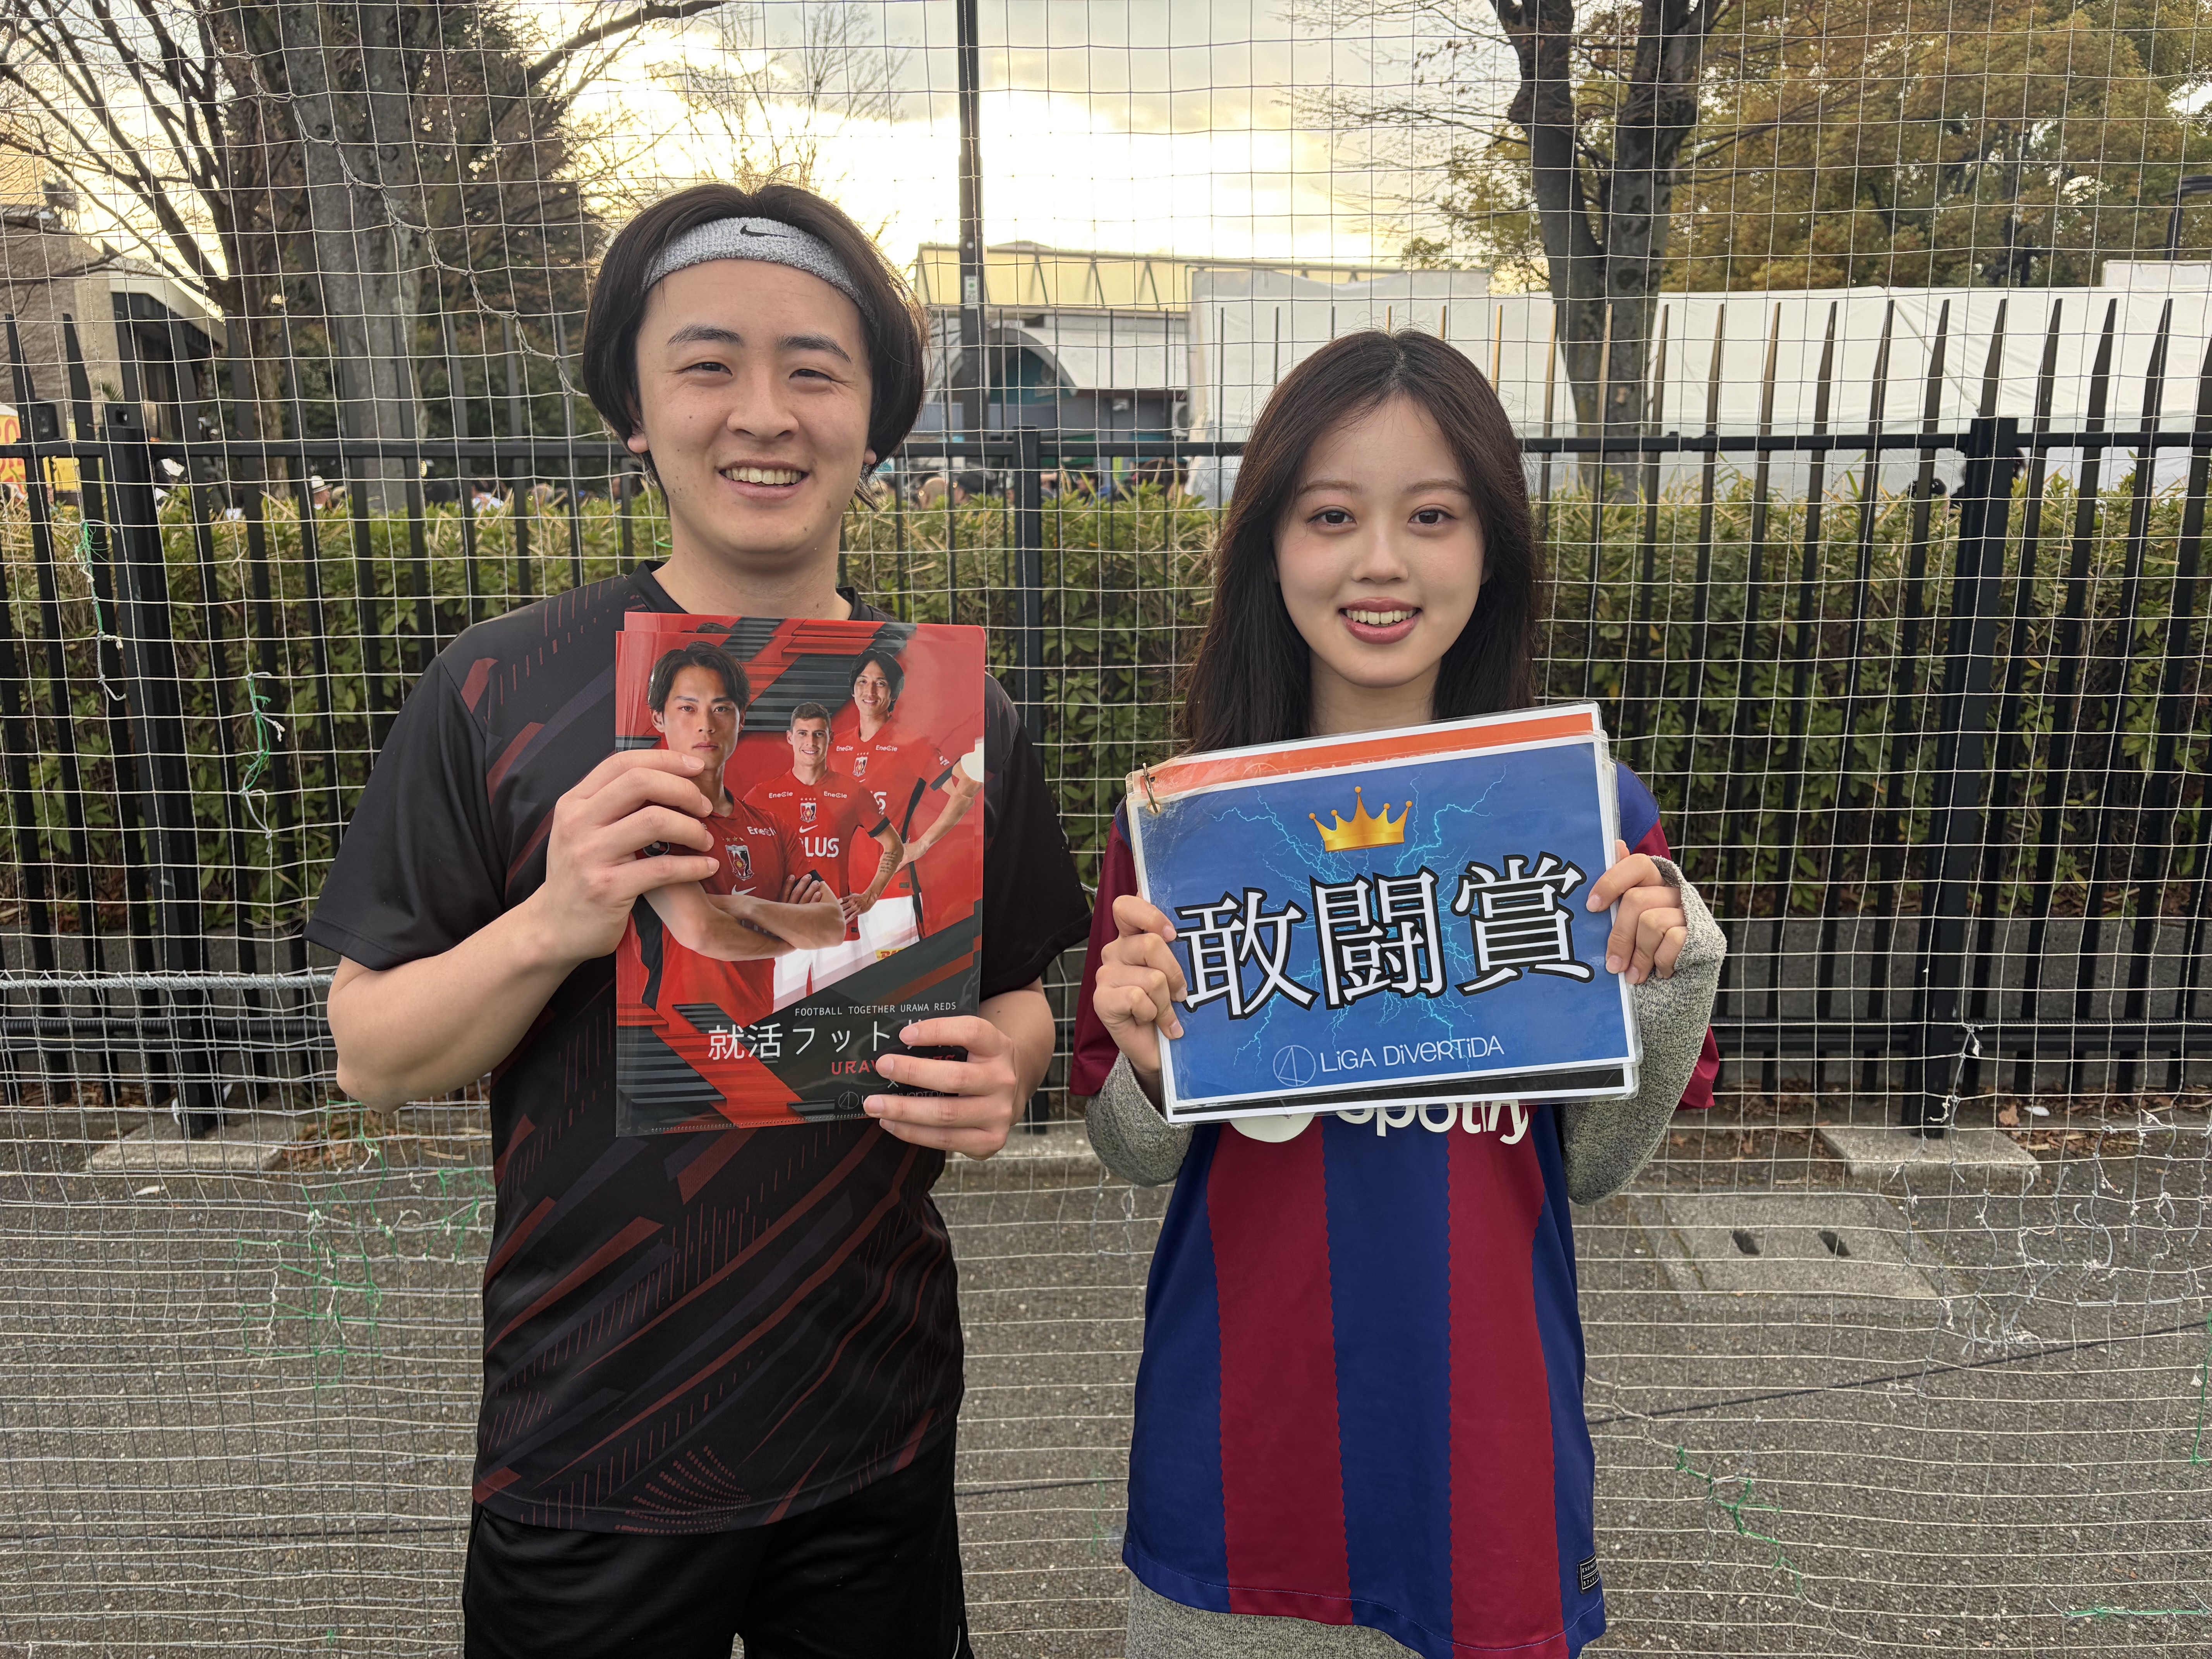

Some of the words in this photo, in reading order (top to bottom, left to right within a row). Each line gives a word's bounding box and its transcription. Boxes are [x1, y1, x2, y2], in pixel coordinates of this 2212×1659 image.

[799, 836, 839, 857] LUS
[1175, 851, 1595, 1020] 敢闘賞
[795, 1007, 842, 1017] FOOTBALL
[848, 1005, 895, 1014] TOGETHER
[900, 1003, 929, 1012] URAWA
[934, 1001, 956, 1011] REDS
[708, 1019, 953, 1060] 就活フット
[831, 1060, 878, 1075] URA
